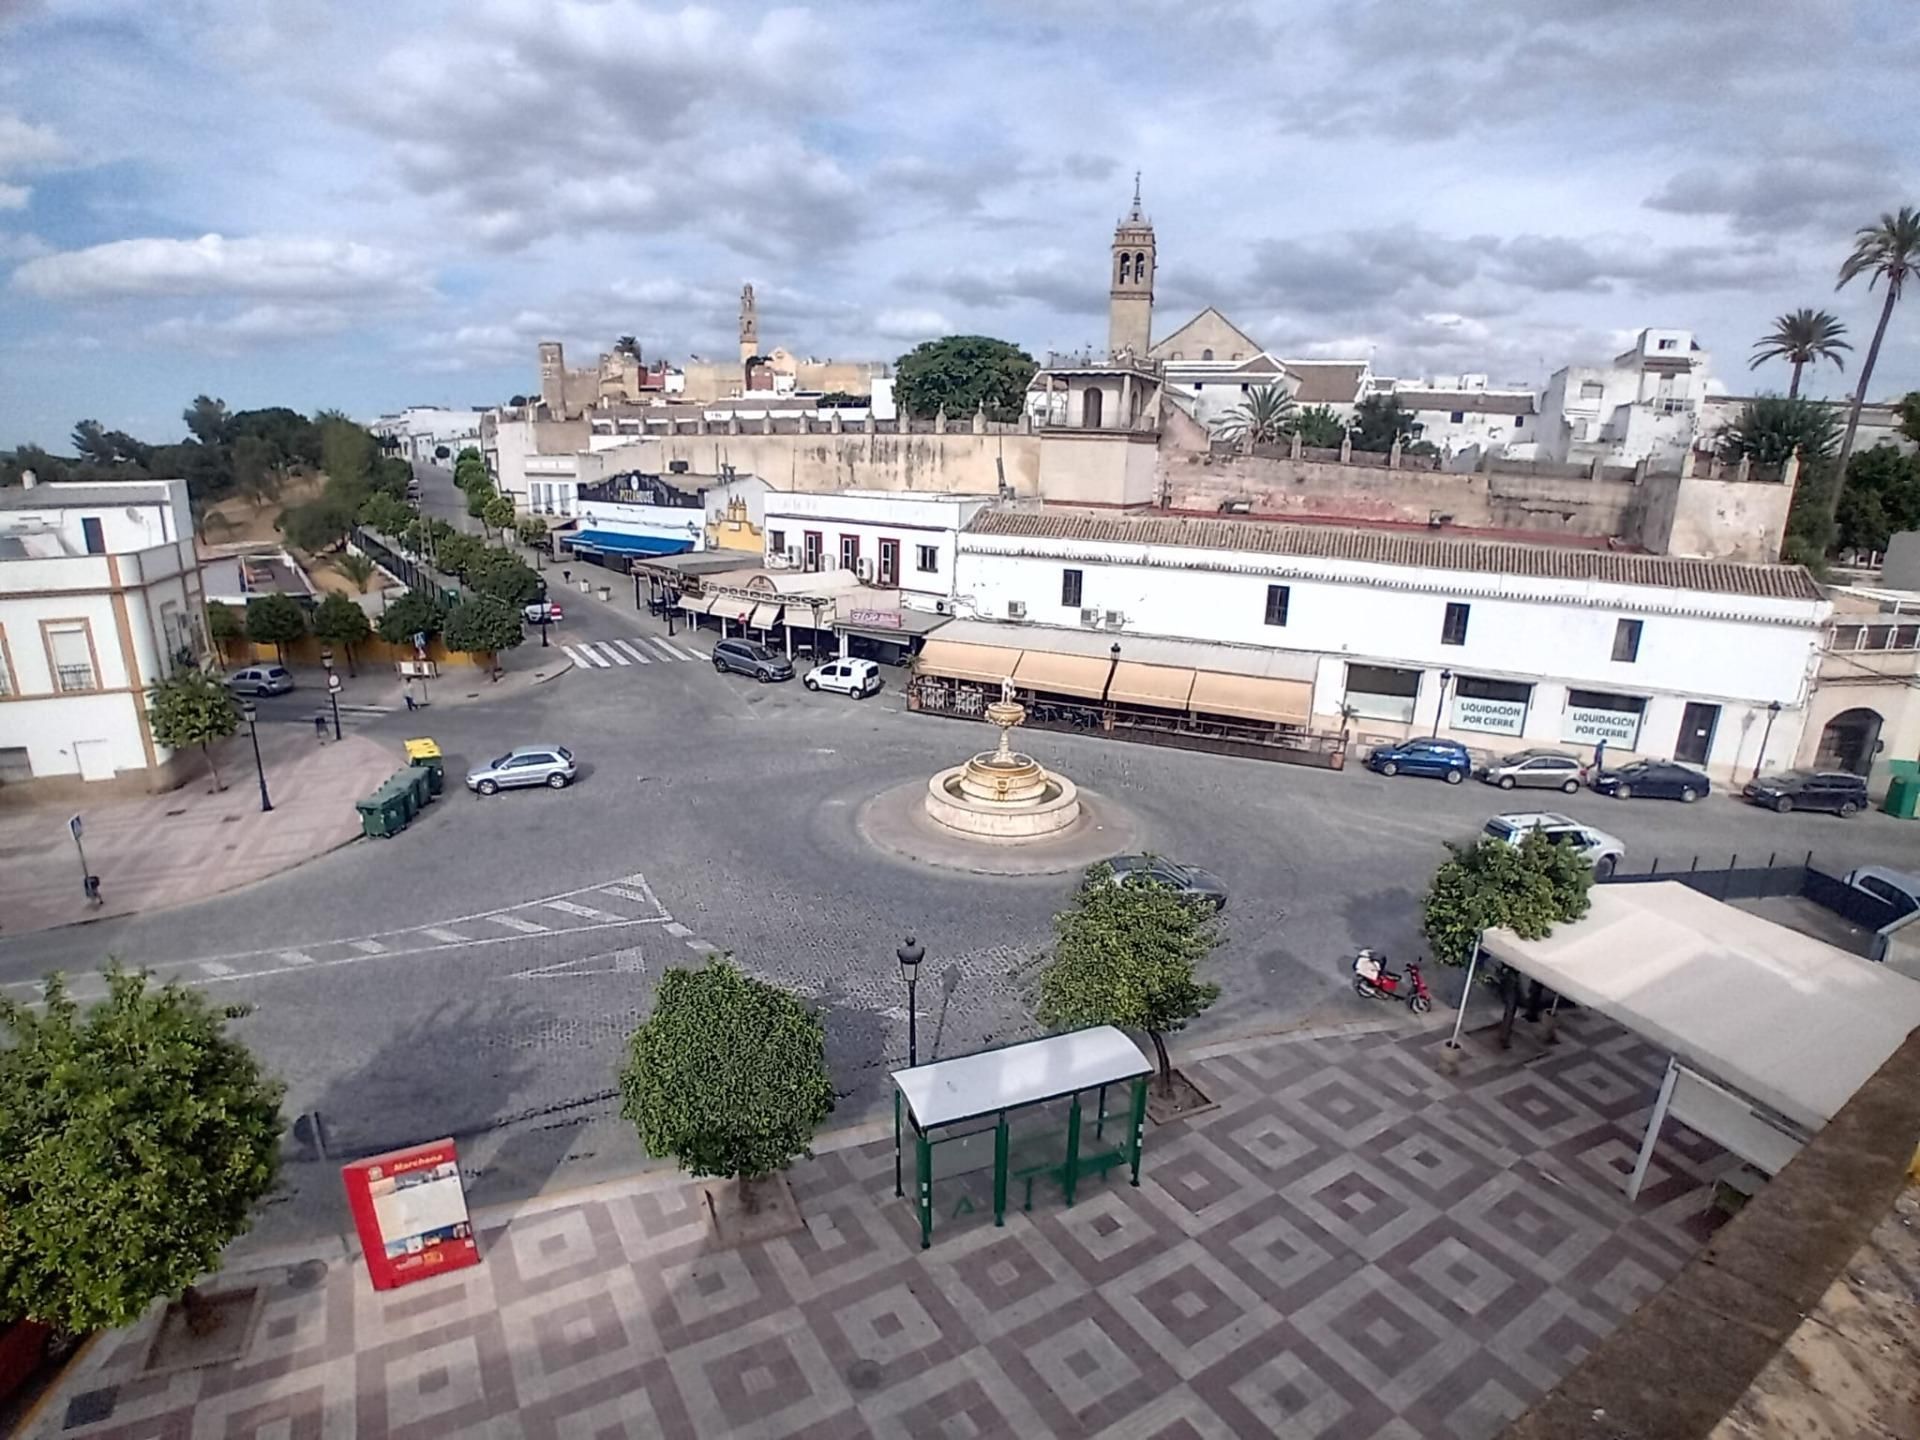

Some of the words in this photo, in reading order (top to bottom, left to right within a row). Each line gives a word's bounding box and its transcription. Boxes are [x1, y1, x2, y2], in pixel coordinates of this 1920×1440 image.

[1463, 714, 1482, 724] POR
[1483, 717, 1515, 728] CIERRE
[1575, 725, 1595, 735] POR
[1596, 728, 1628, 738] CIERRE
